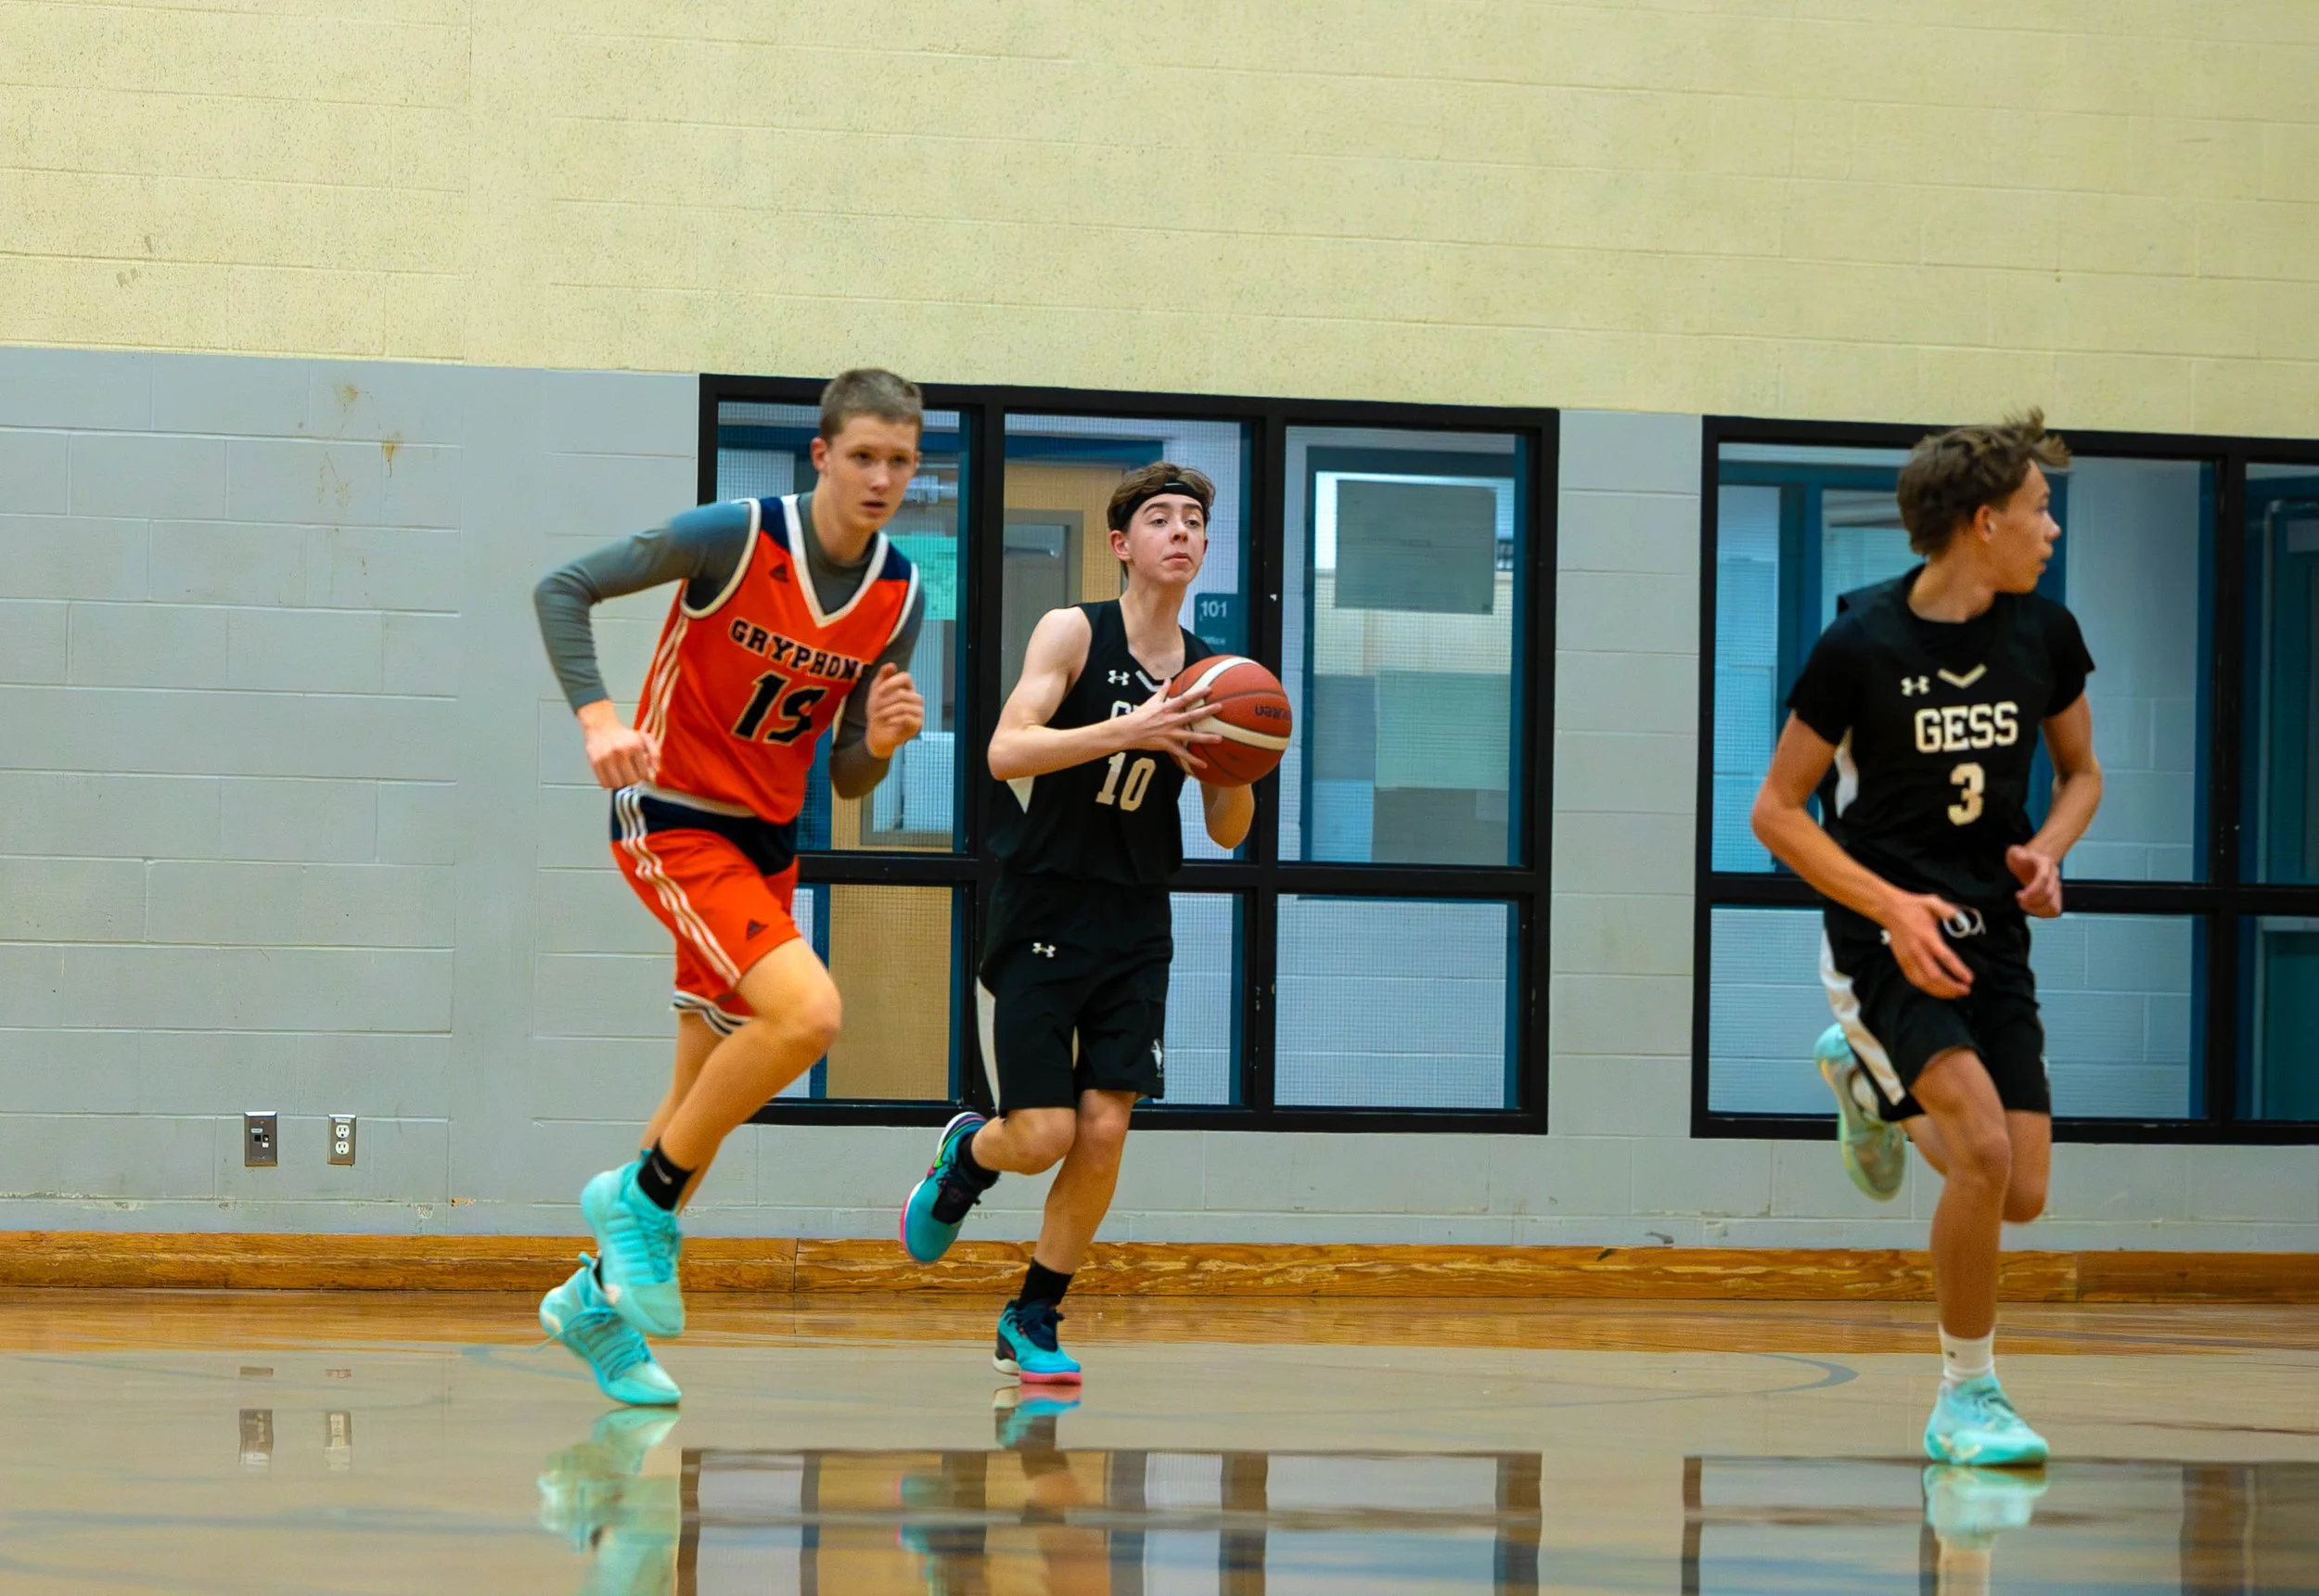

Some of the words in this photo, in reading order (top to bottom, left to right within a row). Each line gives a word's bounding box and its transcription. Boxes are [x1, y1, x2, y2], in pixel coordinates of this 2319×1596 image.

[1200, 600, 1226, 618] 101
[728, 617, 872, 682] GRYPHON
[731, 670, 829, 747] 15
[1915, 700, 2018, 753] GESS
[1095, 752, 1156, 811] 10
[1947, 761, 1985, 826] 3
